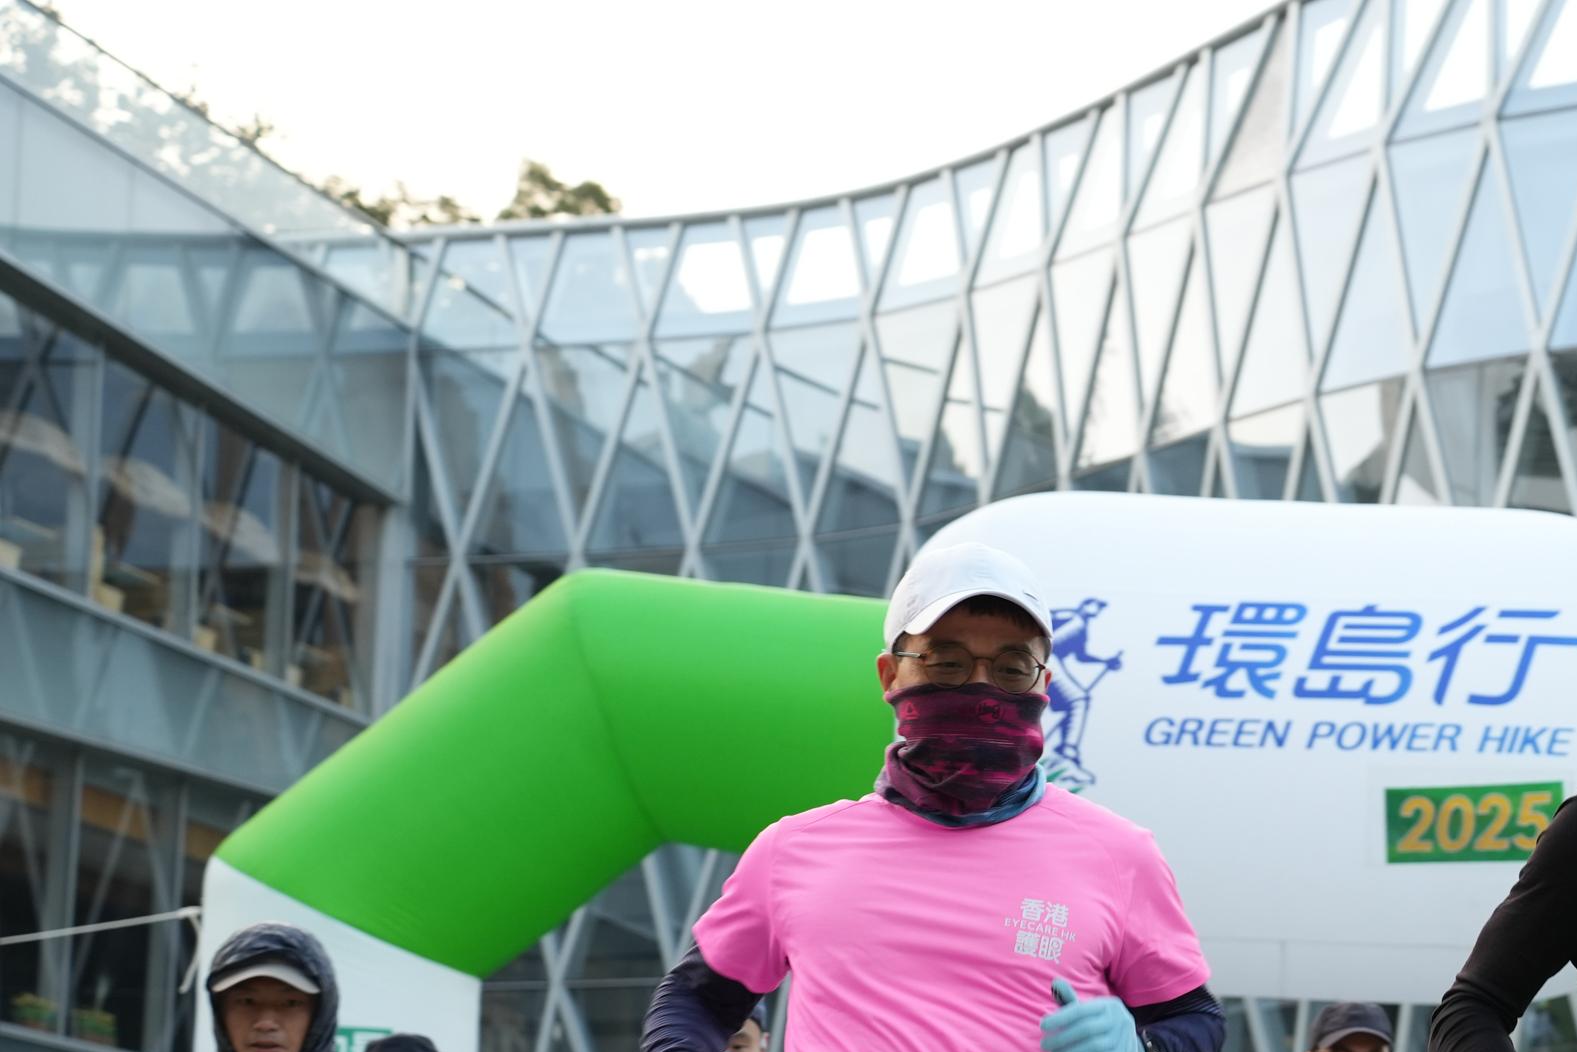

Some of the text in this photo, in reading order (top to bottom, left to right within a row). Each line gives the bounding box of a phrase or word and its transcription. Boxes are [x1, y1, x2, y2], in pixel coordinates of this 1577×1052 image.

[1143, 716, 1576, 757] GREEN POWER HIKE
[1396, 790, 1553, 854] 2025
[1003, 917, 1078, 943] EYECARE HK
[1020, 898, 1070, 929] 香港
[1013, 930, 1066, 966] 護眼
